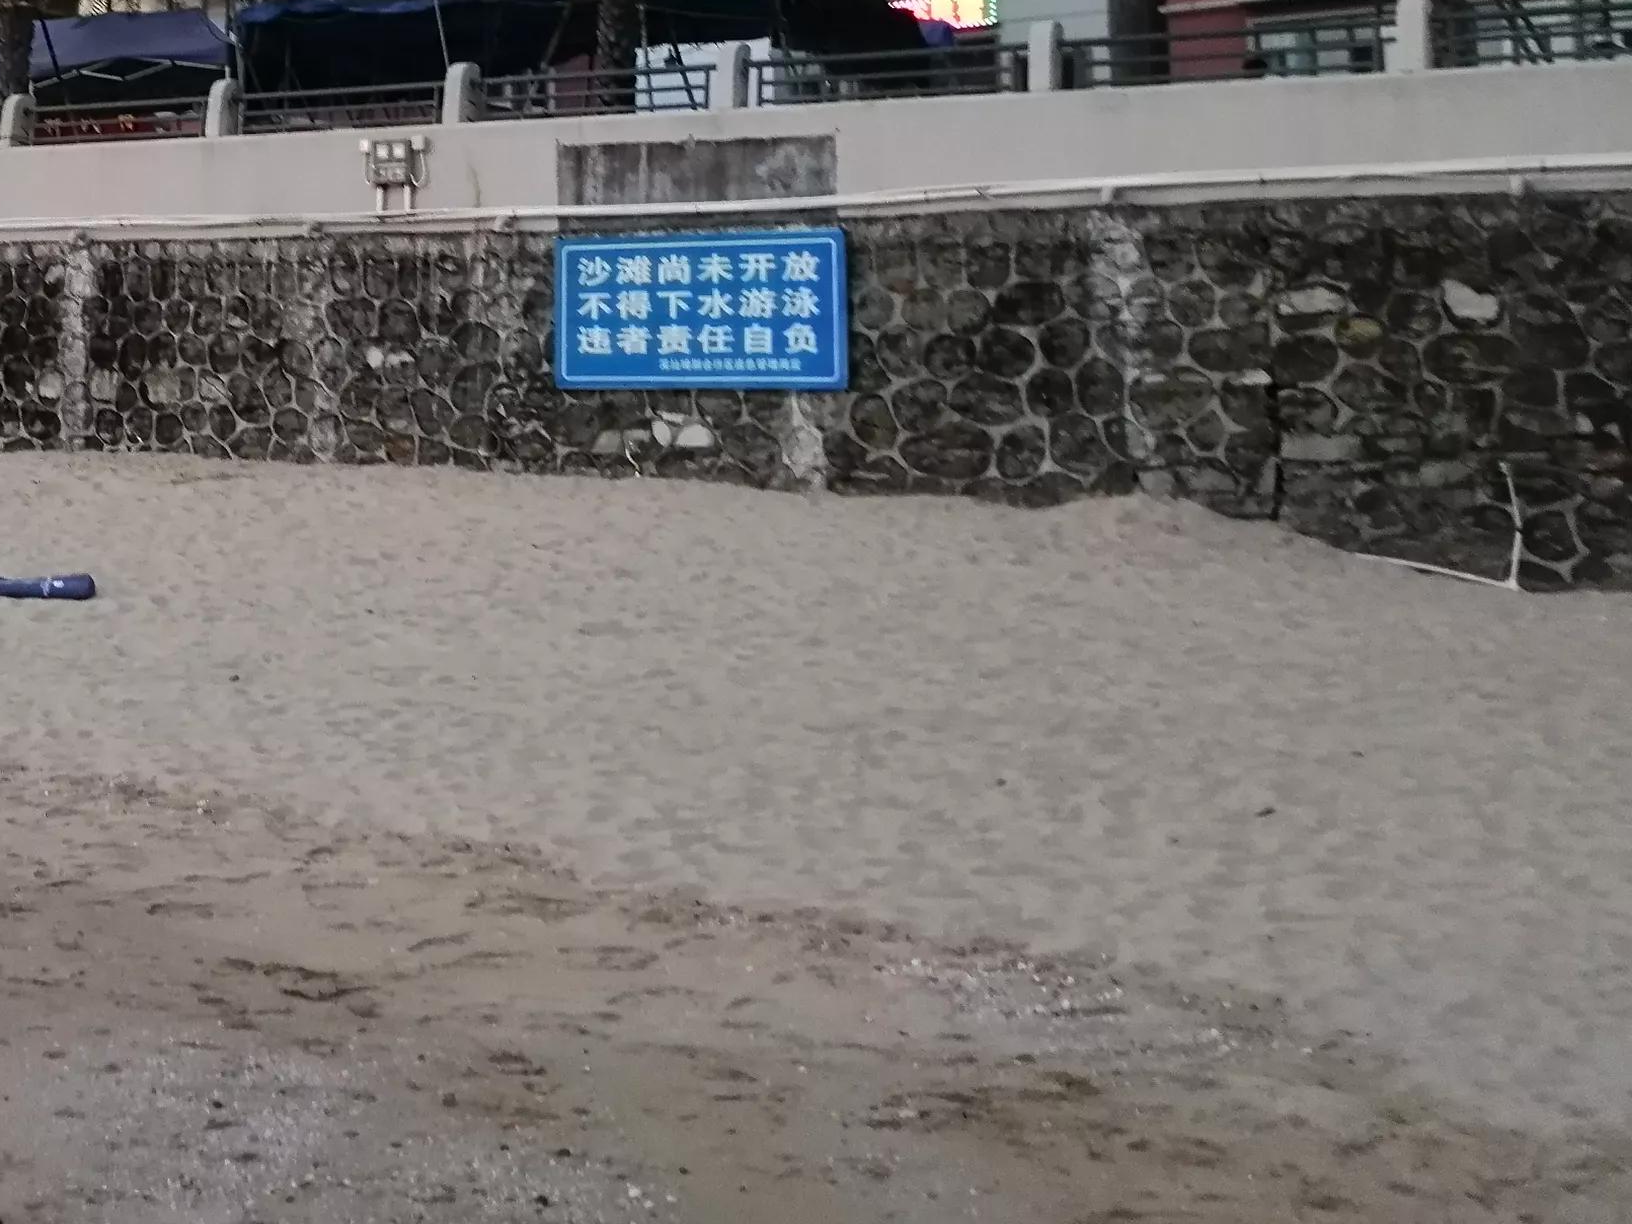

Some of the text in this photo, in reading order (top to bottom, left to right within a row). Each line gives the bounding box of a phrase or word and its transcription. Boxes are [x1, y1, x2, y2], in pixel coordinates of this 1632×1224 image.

[577, 250, 821, 287] 沙滩尚未开放
[576, 286, 822, 321] 不得下水游泳
[576, 322, 819, 356] 违者责任自负
